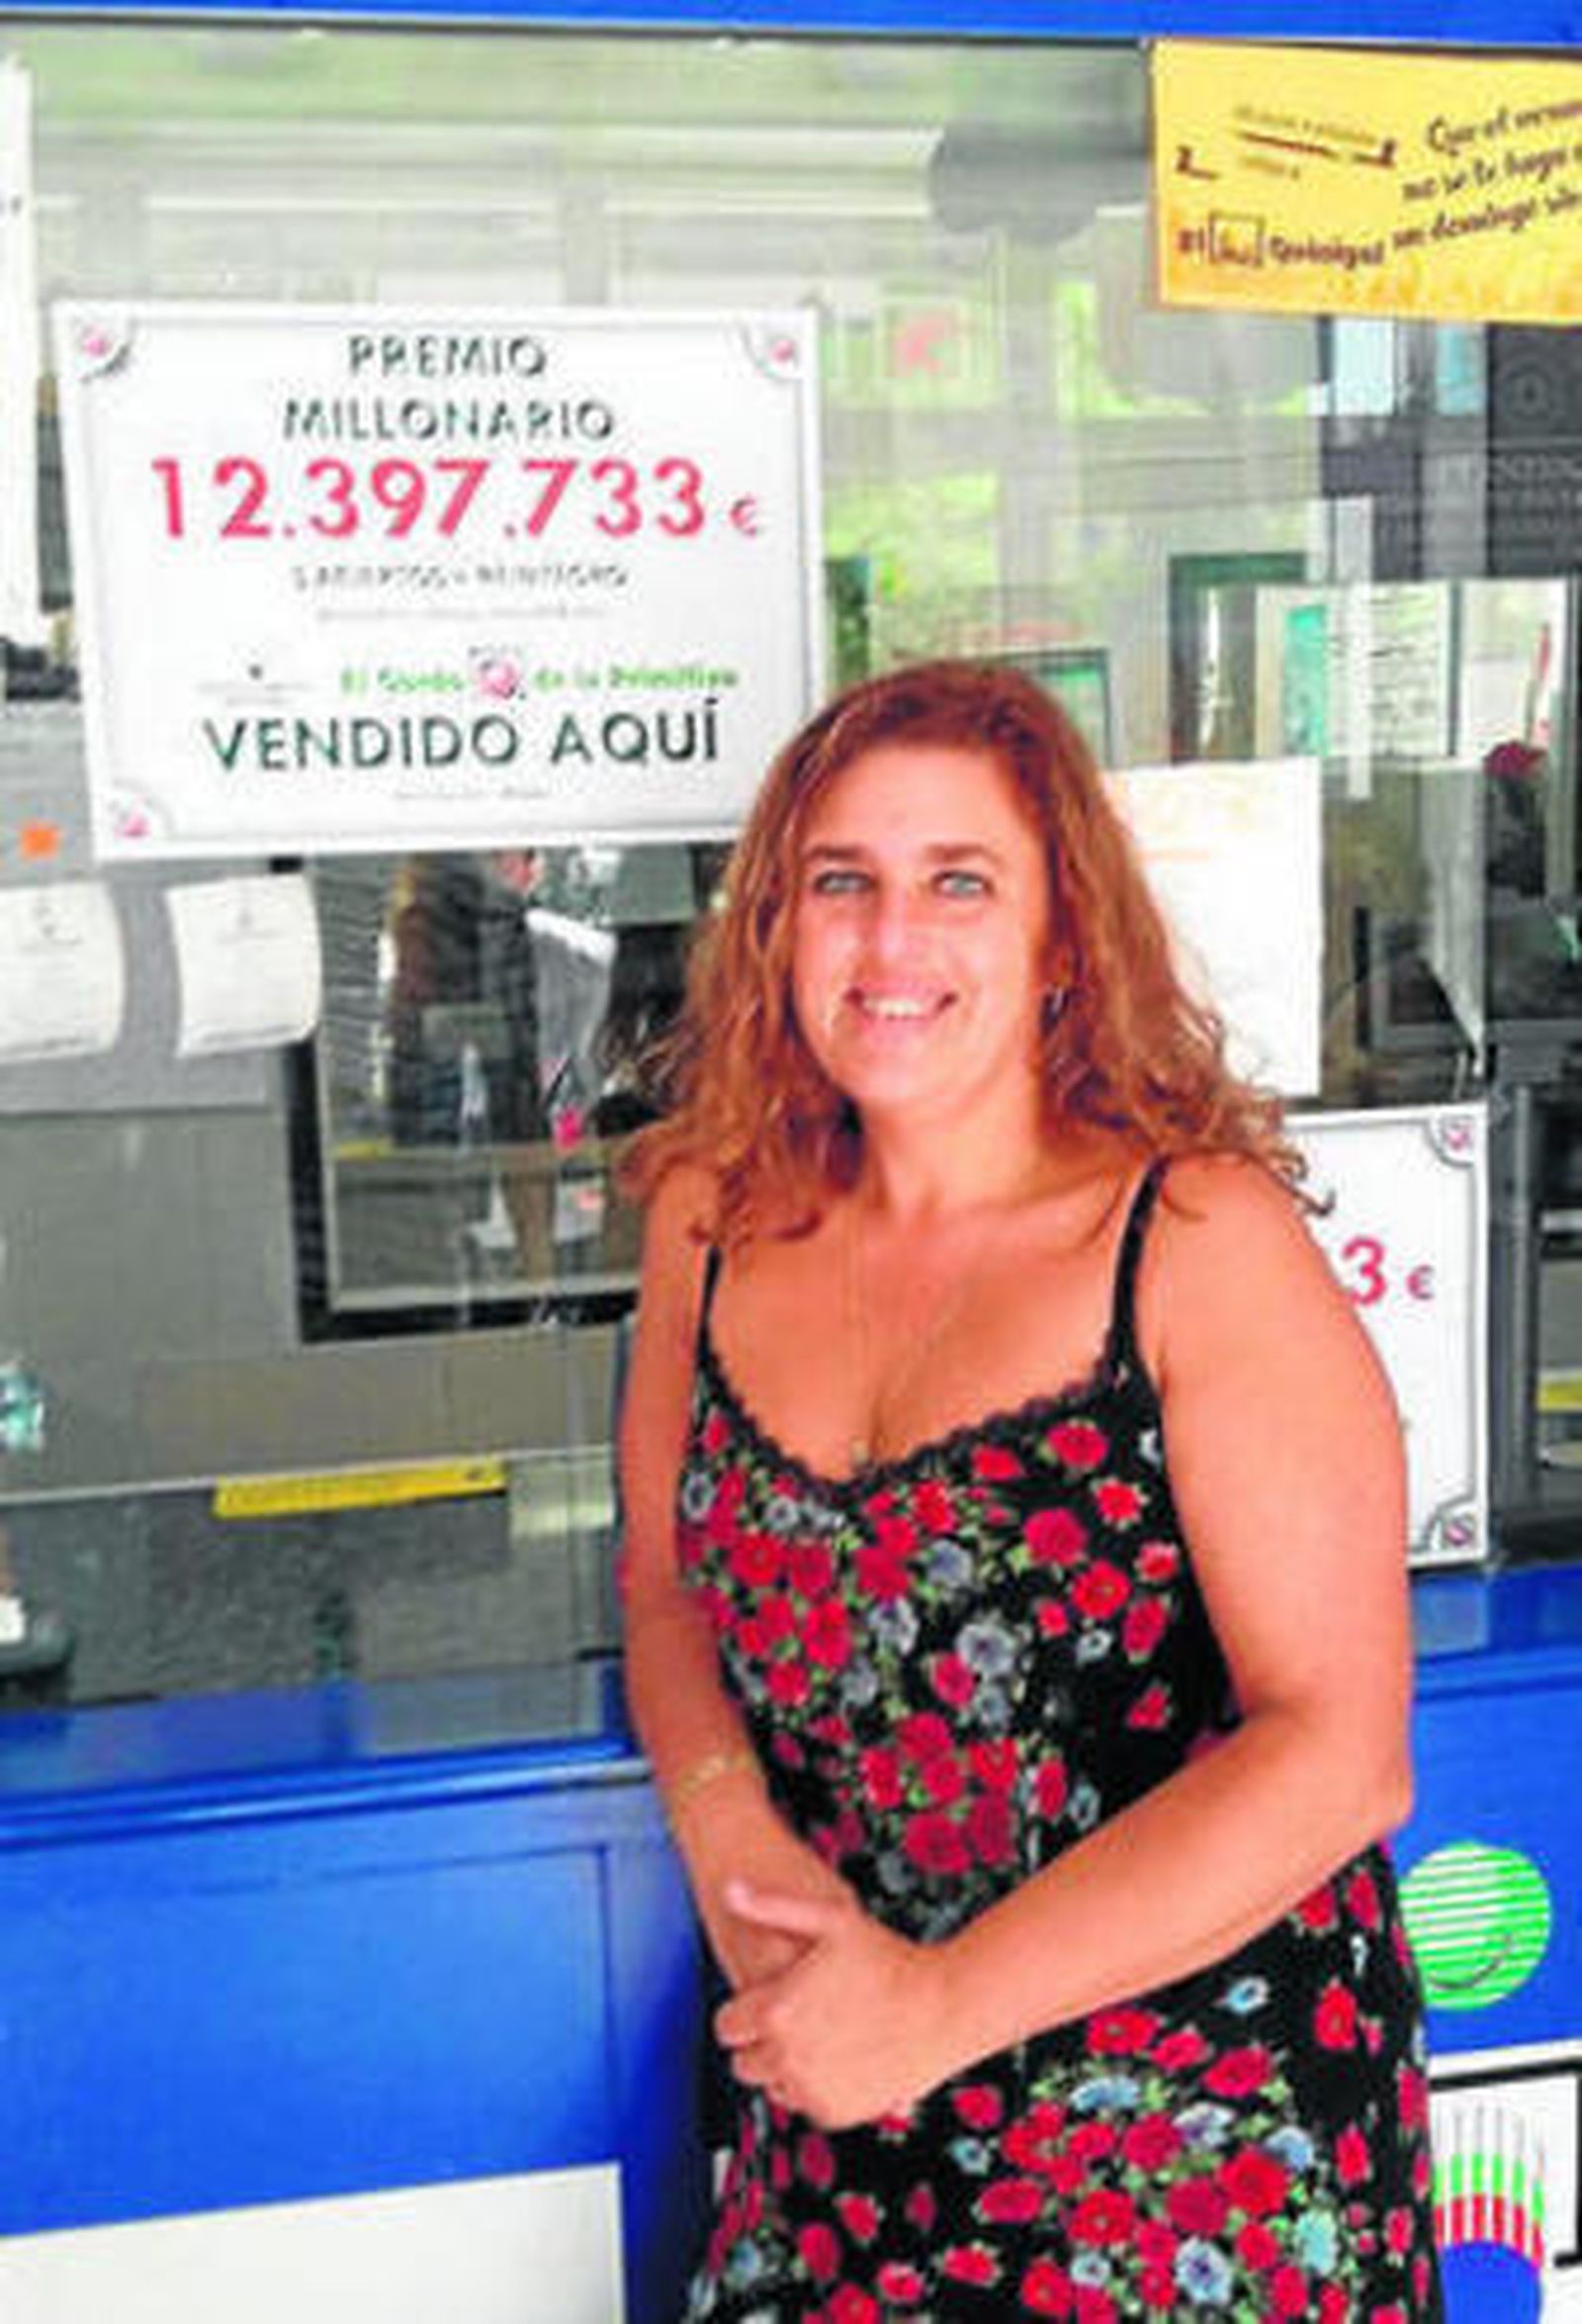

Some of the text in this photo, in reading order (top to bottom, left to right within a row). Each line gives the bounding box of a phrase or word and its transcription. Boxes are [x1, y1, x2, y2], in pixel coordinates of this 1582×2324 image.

[349, 335, 547, 378] PREMIO
[283, 399, 614, 441] MILLONARIO
[151, 455, 758, 541] 12.397.733 €
[203, 695, 720, 771] VENDIDO AQUÍ
